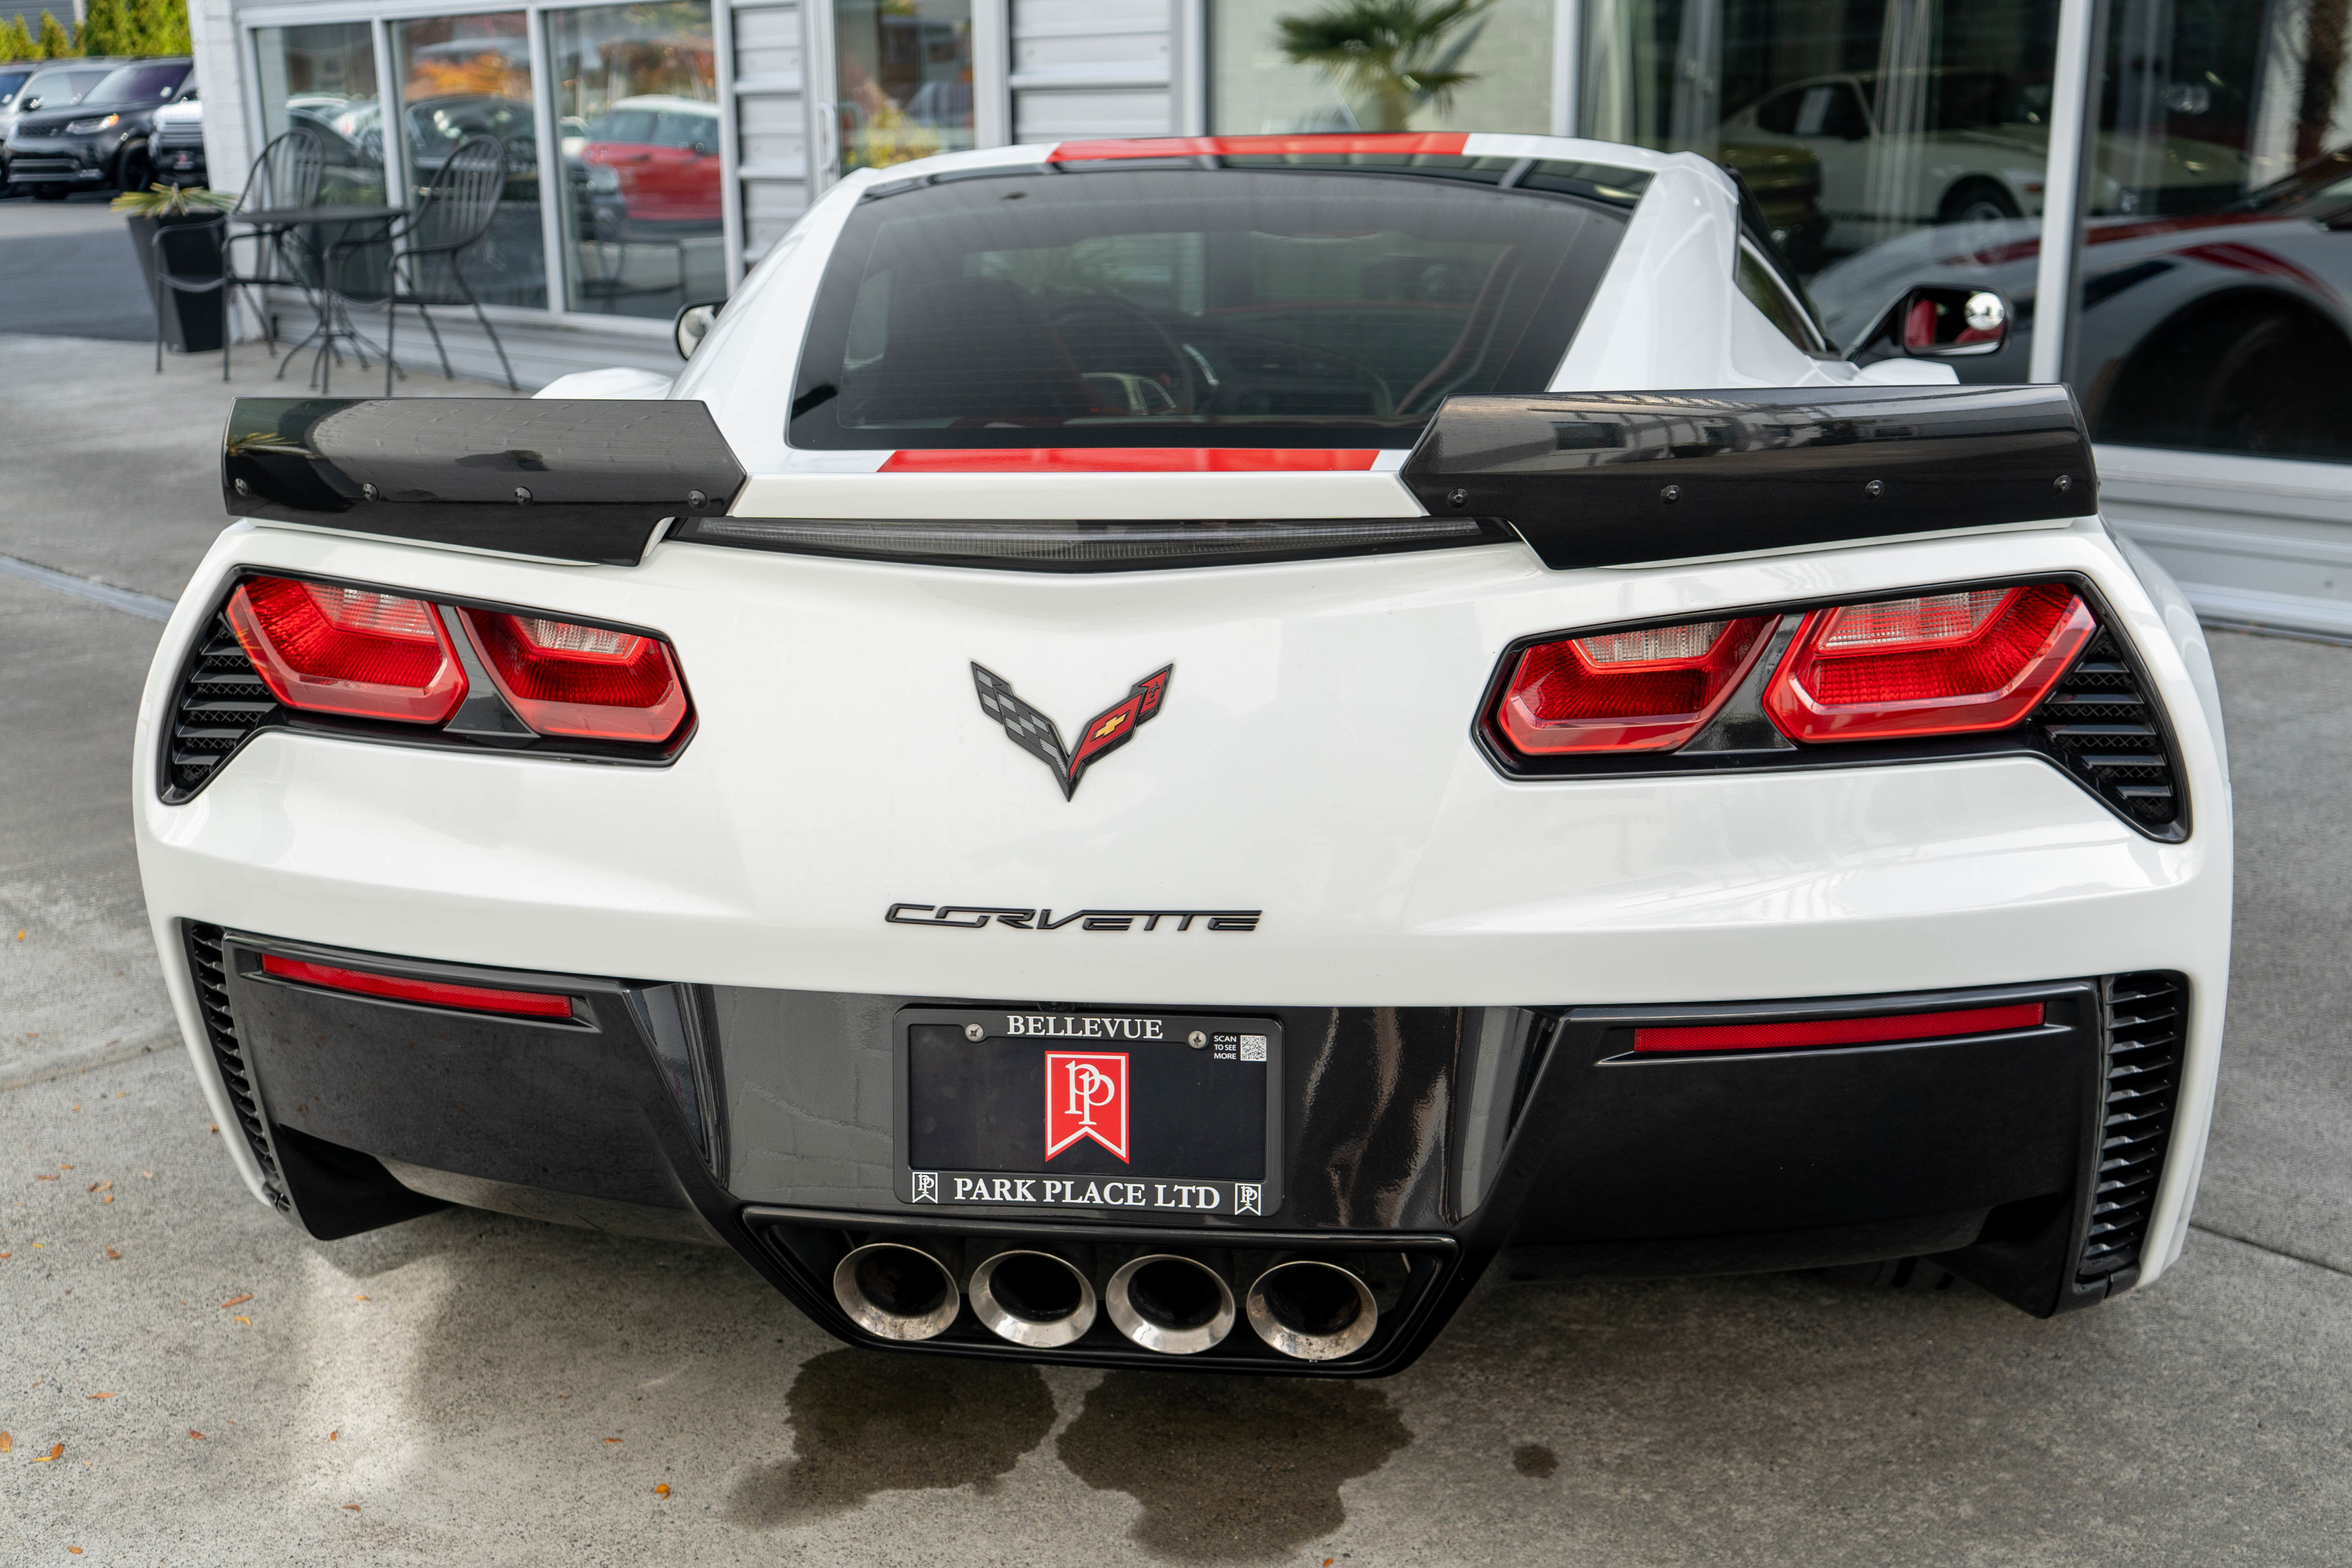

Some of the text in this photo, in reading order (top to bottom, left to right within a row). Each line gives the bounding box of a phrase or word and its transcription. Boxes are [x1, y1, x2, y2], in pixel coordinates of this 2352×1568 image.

[885, 903, 1262, 931] CORVETTE
[1007, 1015, 1163, 1039] BELLEVUE
[954, 1177, 1220, 1209] PARK PLACE LTD
